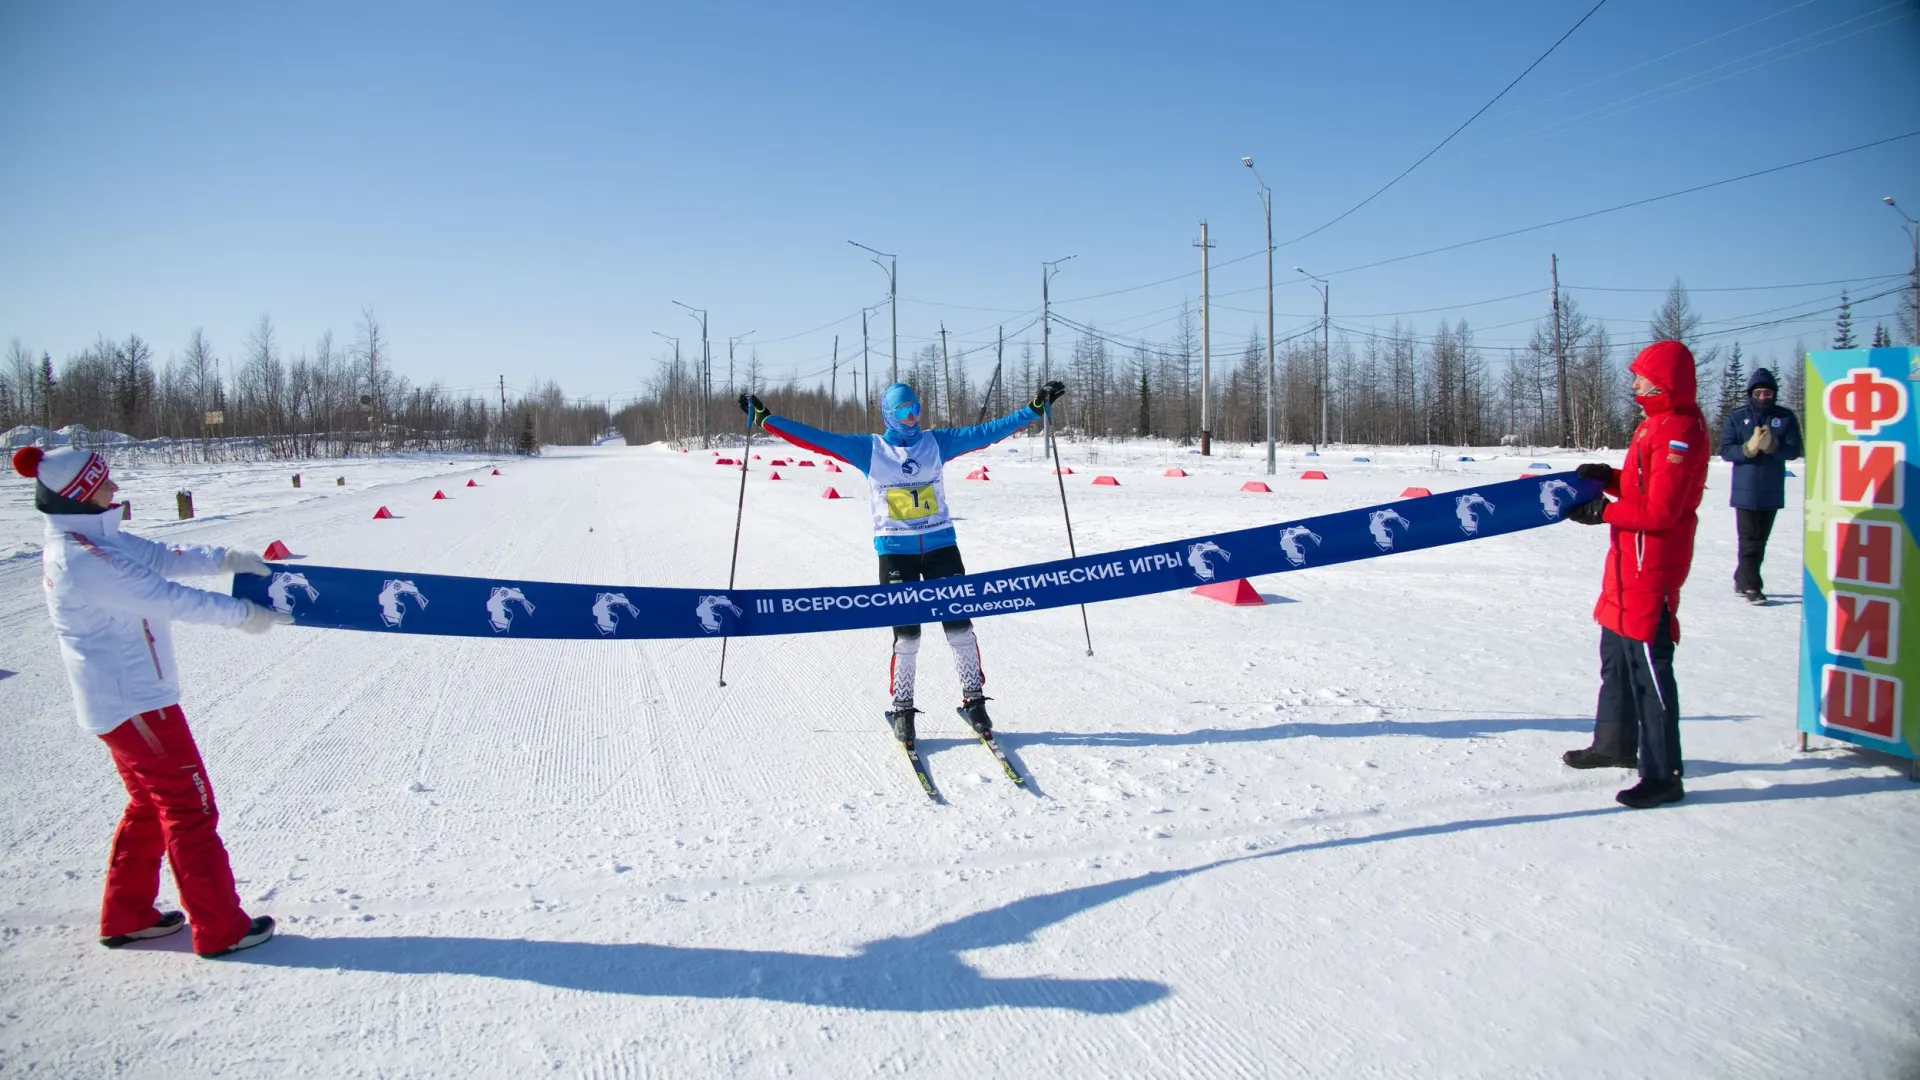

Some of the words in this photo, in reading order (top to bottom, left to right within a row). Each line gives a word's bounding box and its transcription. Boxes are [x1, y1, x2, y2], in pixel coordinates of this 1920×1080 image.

[910, 489, 919, 508] 1
[1822, 368, 1904, 742] ФИНИШ
[781, 583, 976, 613] ВСЕРОССИЙСКИЕ
[982, 561, 1125, 595] АРКТИЧЕСКИЕ
[1129, 551, 1183, 575] ИГРЫ
[931, 607, 944, 617] г.
[948, 597, 1036, 615] Салехард
